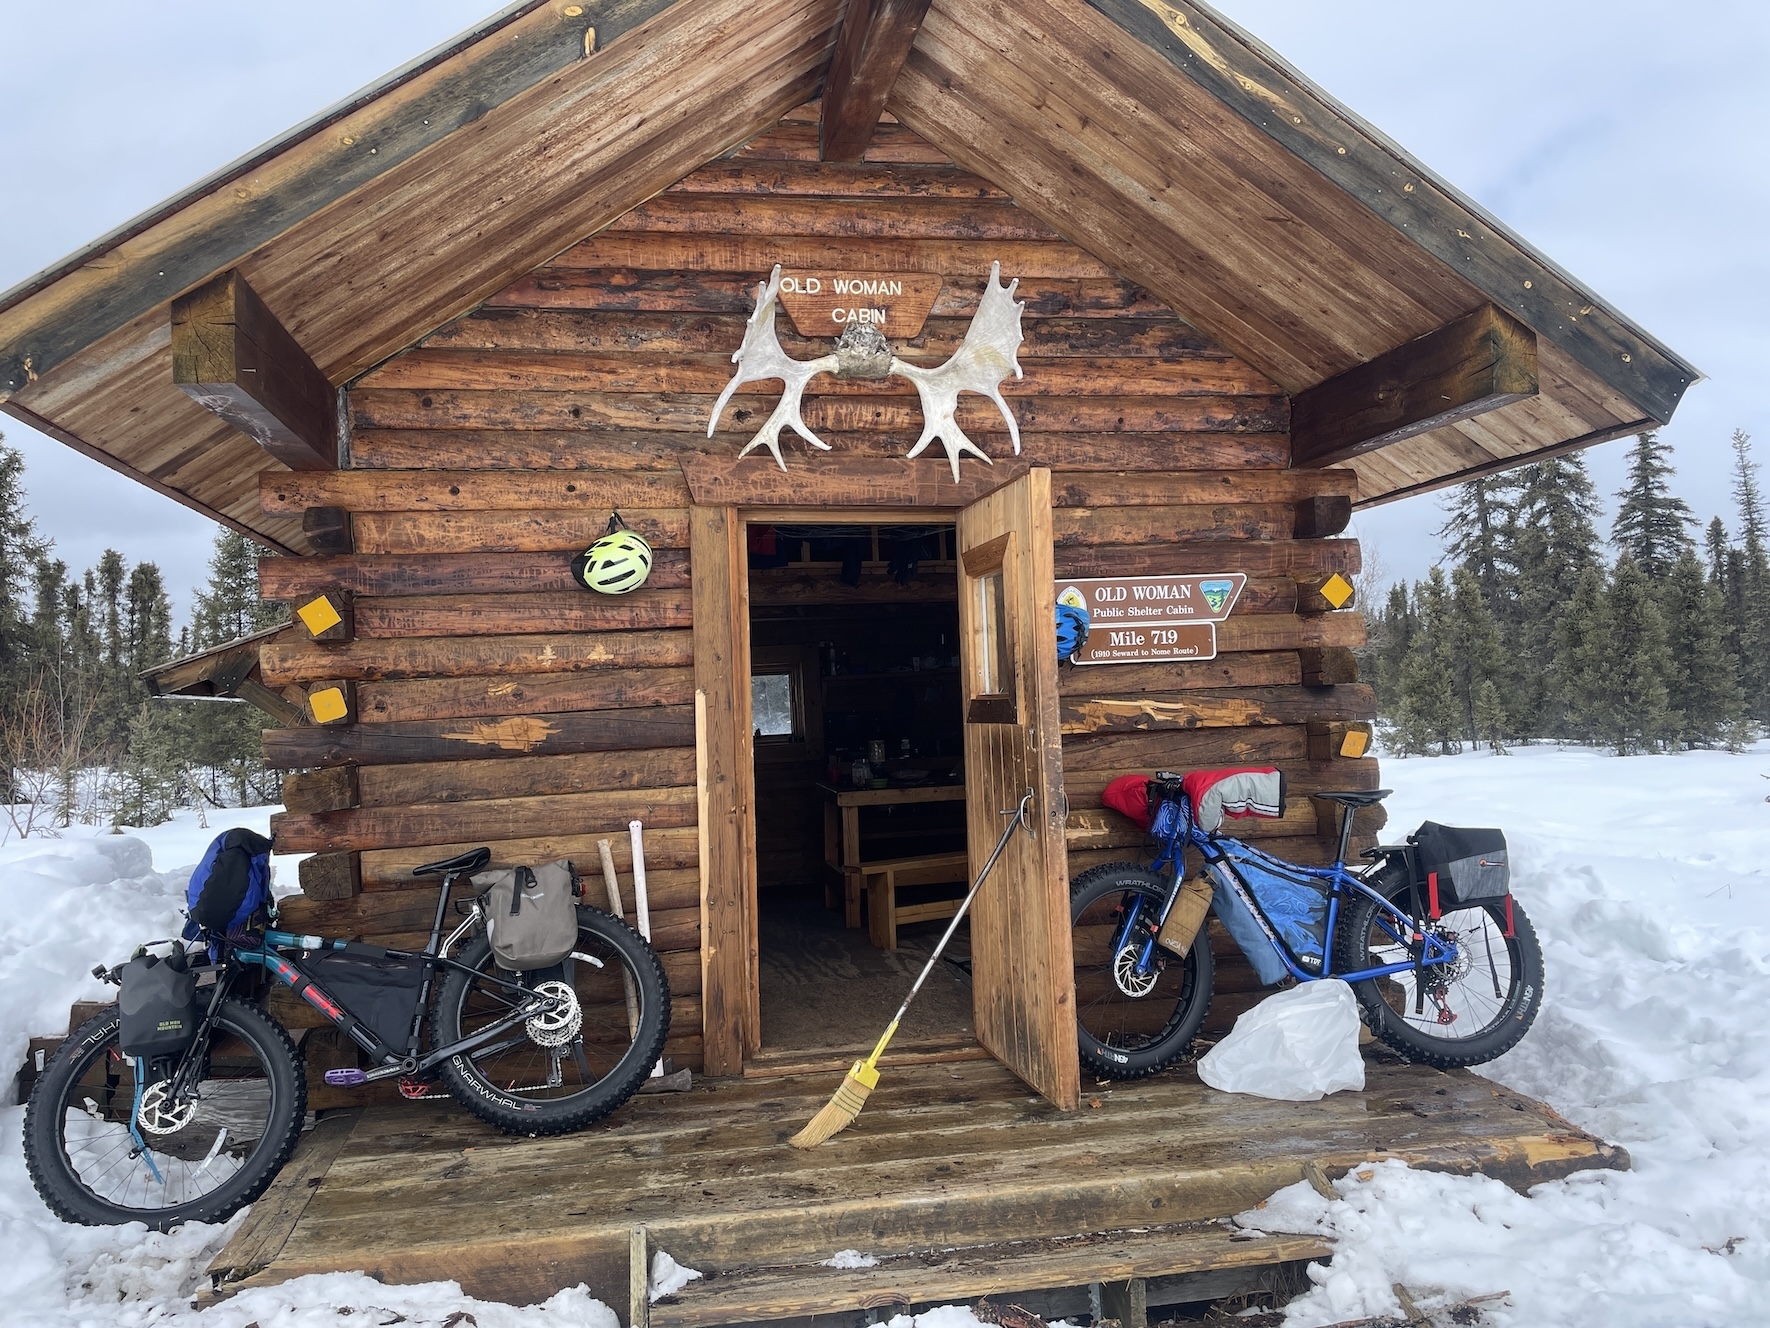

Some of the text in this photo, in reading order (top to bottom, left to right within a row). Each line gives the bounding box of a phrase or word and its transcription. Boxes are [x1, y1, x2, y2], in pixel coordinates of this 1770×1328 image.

[780, 277, 902, 296] OLD WOMAN
[831, 307, 886, 324] CABIN
[1095, 586, 1128, 602] OLD
[1133, 584, 1192, 600] WOMAN
[1092, 605, 1194, 618] Public Shelter Cabin
[1110, 629, 1178, 647] Mile 719
[1090, 649, 1110, 660] (1910
[1112, 648, 1139, 658] Seward
[1151, 647, 1171, 656] Nome
[1173, 645, 1199, 656] Route)
[452, 1054, 522, 1110] GNARWHAL
